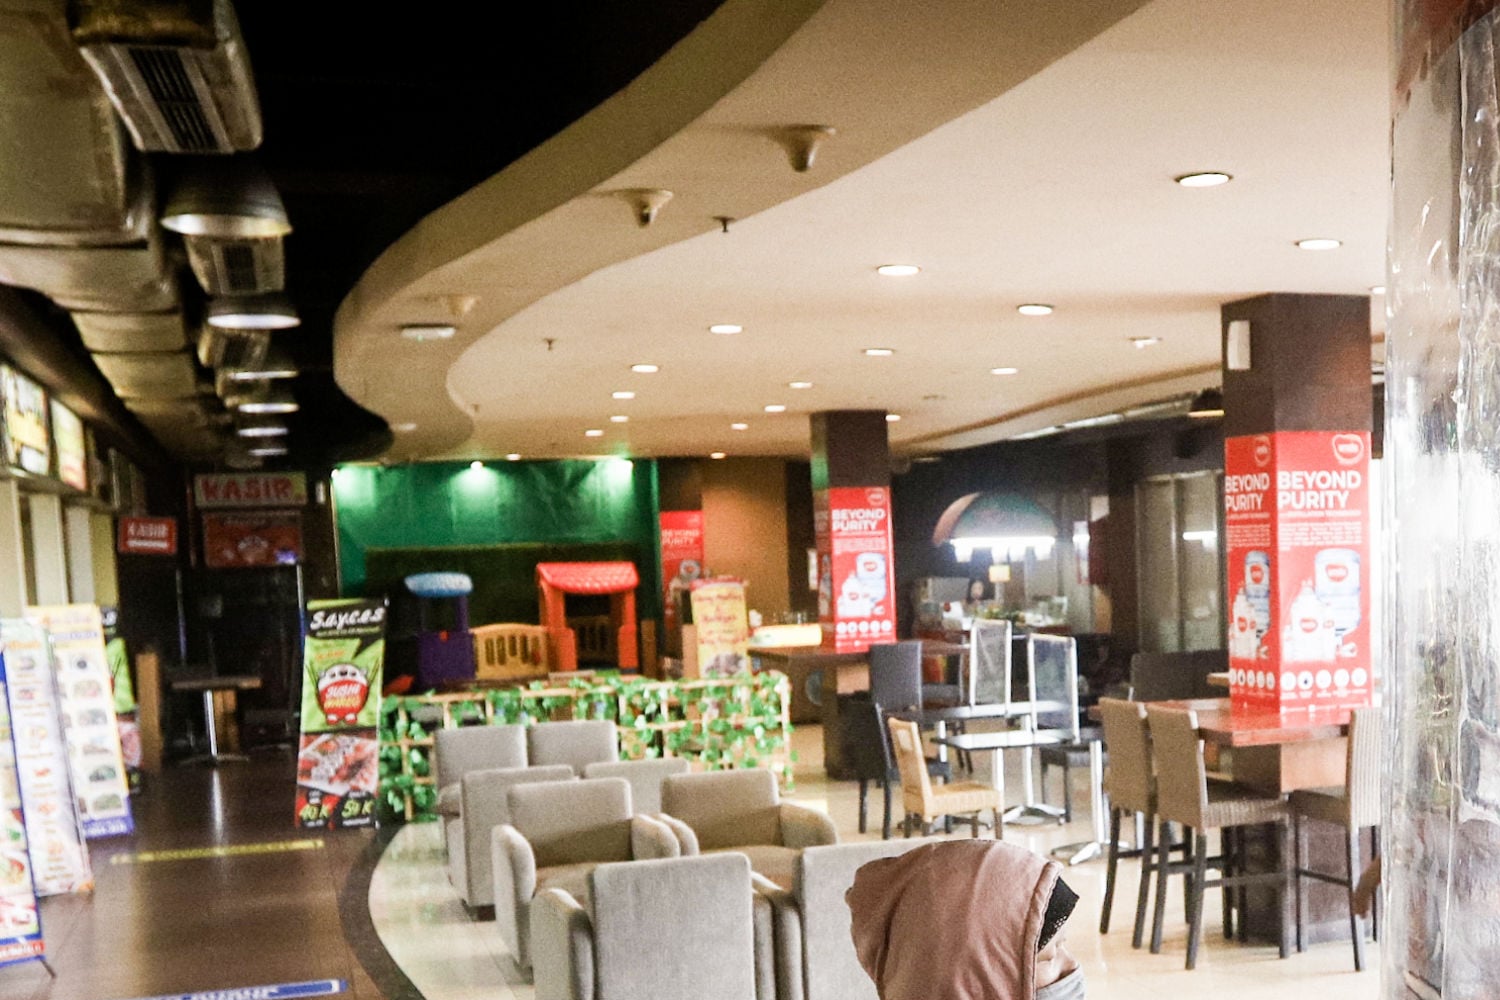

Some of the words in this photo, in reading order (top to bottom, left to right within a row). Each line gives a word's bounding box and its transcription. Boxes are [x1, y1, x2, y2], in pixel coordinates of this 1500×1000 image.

[201, 476, 293, 499] KASIR
[1225, 472, 1270, 494] BEYOND
[1278, 470, 1361, 490] BEYOND
[1225, 493, 1263, 512] PURITY
[1278, 490, 1350, 510] PURITY
[831, 508, 885, 521] BEYOND
[831, 519, 878, 532] PURITY
